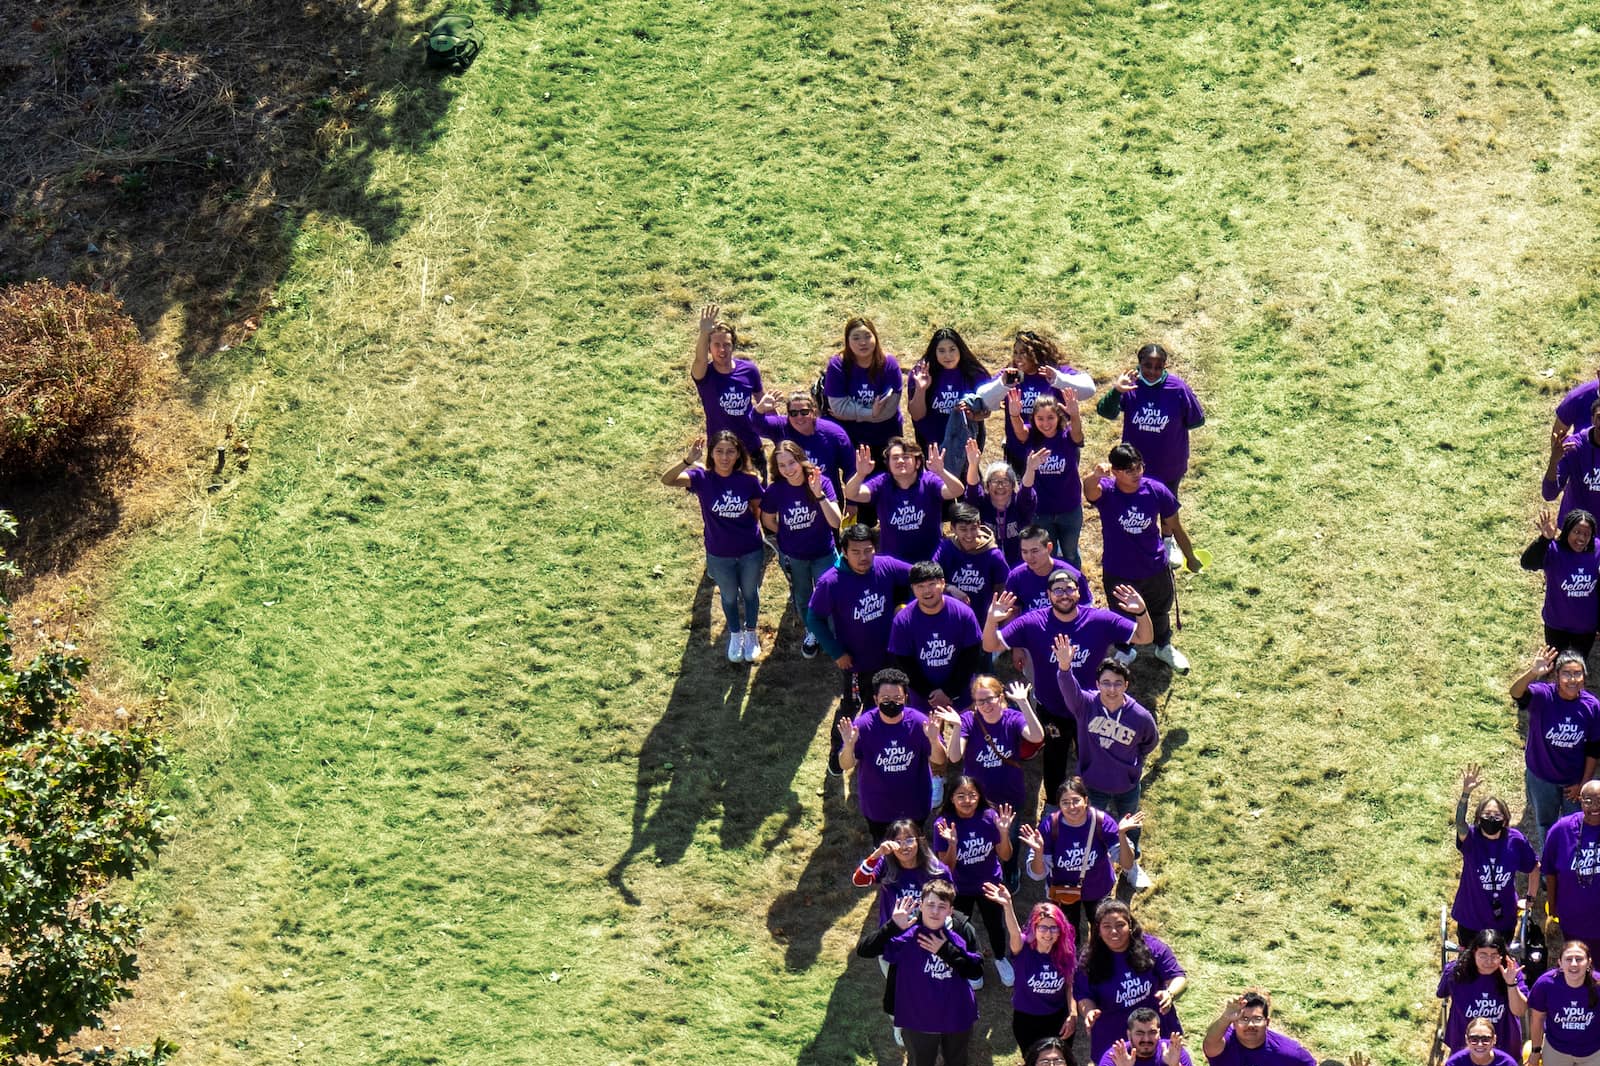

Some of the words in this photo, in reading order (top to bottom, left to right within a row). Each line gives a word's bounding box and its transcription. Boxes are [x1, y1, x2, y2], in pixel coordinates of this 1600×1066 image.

[858, 390, 875, 399] YOU
[941, 391, 959, 399] YOU
[1143, 407, 1160, 416] YOU
[1132, 412, 1169, 427] belong
[722, 495, 740, 503] YOU
[712, 499, 748, 515] belong
[789, 507, 808, 516] YOU
[898, 507, 915, 515] YOU
[784, 510, 817, 526] belong
[890, 511, 926, 526] belong
[1128, 511, 1144, 520] YOU
[790, 522, 812, 530] HERE
[1119, 515, 1152, 529] belong
[961, 569, 979, 577] YOU
[952, 573, 985, 589] belong
[1571, 574, 1591, 583] YOU
[959, 585, 979, 593] HERE
[1561, 579, 1597, 592] belong
[1567, 589, 1589, 597] HERE
[859, 593, 878, 605] YOU
[854, 599, 885, 620] belong
[862, 611, 882, 623] HERE
[927, 640, 945, 648] YOU
[920, 644, 955, 660] belong
[927, 657, 949, 666] HERE
[1558, 724, 1577, 732] YOU
[1545, 727, 1585, 743] belong
[1552, 740, 1575, 748] HERE
[884, 747, 905, 755] YOU
[876, 750, 914, 766] belong
[884, 764, 907, 772] HERE
[963, 838, 984, 848] YOU
[956, 840, 992, 860] belong
[964, 855, 986, 864] HERE
[1027, 975, 1065, 990] belong
[1121, 977, 1141, 989] YOU
[1116, 980, 1153, 1003] belong
[1465, 1004, 1504, 1018] belong
[1563, 1007, 1584, 1015] YOU
[1554, 1012, 1595, 1026] belong
[1562, 1022, 1585, 1030] HERE
